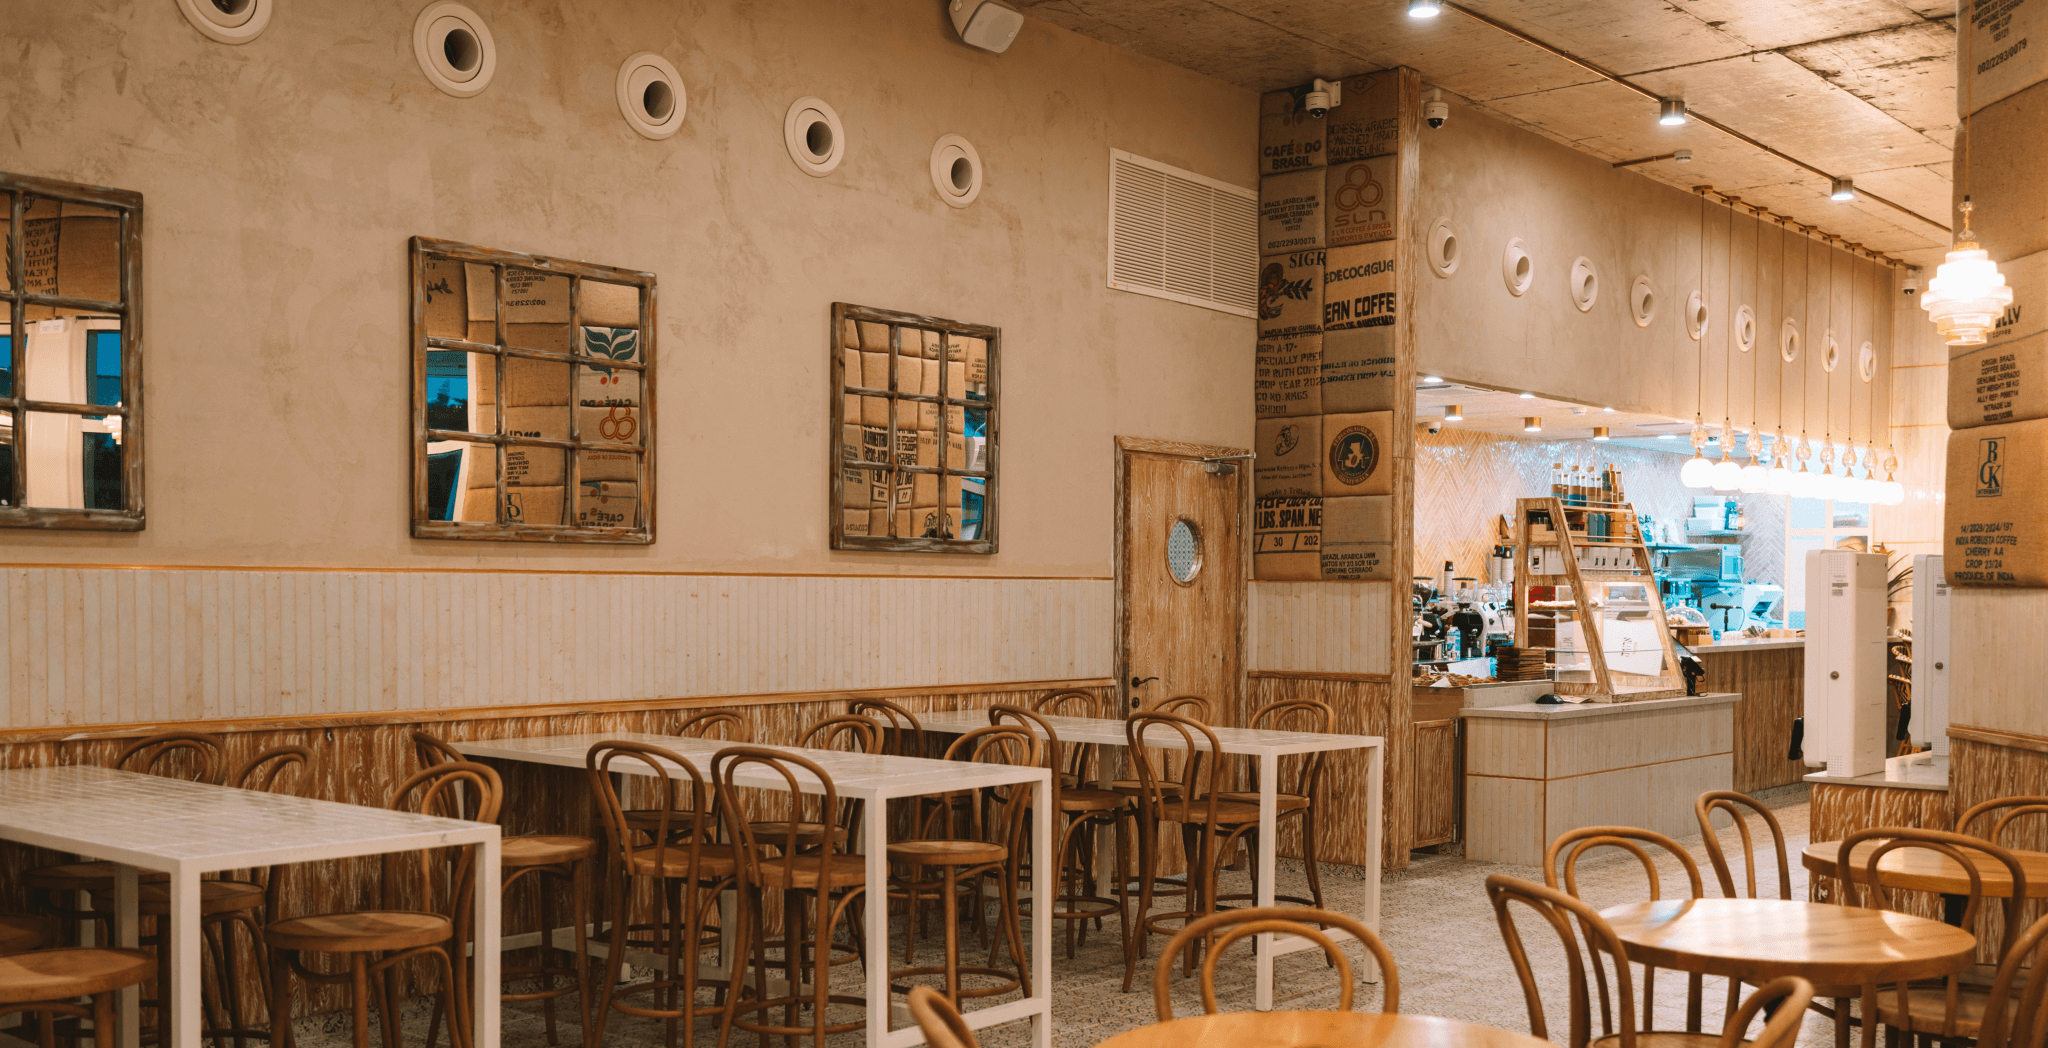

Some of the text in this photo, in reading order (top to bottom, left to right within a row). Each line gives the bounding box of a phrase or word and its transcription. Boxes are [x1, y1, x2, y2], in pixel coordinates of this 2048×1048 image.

[1977, 38, 2027, 75] 002/2293/0079
[1364, 117, 1398, 133] ARABIC
[1305, 140, 1322, 154] DO
[1329, 142, 1385, 158] MANDHELING
[1272, 155, 1312, 170] BRASIL
[1261, 208, 1280, 216] SANTOS
[1345, 226, 1366, 234] COFFEE
[1371, 222, 1391, 230] SPICES
[1331, 234, 1362, 244] EXPORTS
[1378, 229, 1392, 237] LTD
[1267, 237, 1316, 249] 002/2293/0079
[1325, 300, 1350, 324] EAN
[1283, 325, 1297, 333] NEW
[1298, 323, 1322, 332] GUINEA
[1999, 354, 2015, 363] BRAZIL
[1273, 367, 1295, 378] RUTH
[1981, 363, 2016, 375] COFFEE BEANS
[1997, 370, 2020, 380] CERRADO
[1255, 380, 1276, 390] CROP
[1278, 379, 1301, 390] YEAR
[1976, 386, 1986, 394] NET
[1273, 535, 1319, 547] 30 202
[1970, 535, 1995, 545] ROBUSTA
[1996, 535, 2018, 546] COFFEE
[1340, 552, 1363, 560] ARABICA
[1965, 547, 1991, 557] CHERRY
[1965, 559, 2002, 569] CROP 23/24
[1348, 566, 1373, 574] CERRADO
[1954, 571, 2016, 582] PRODUCE OF INDIA
